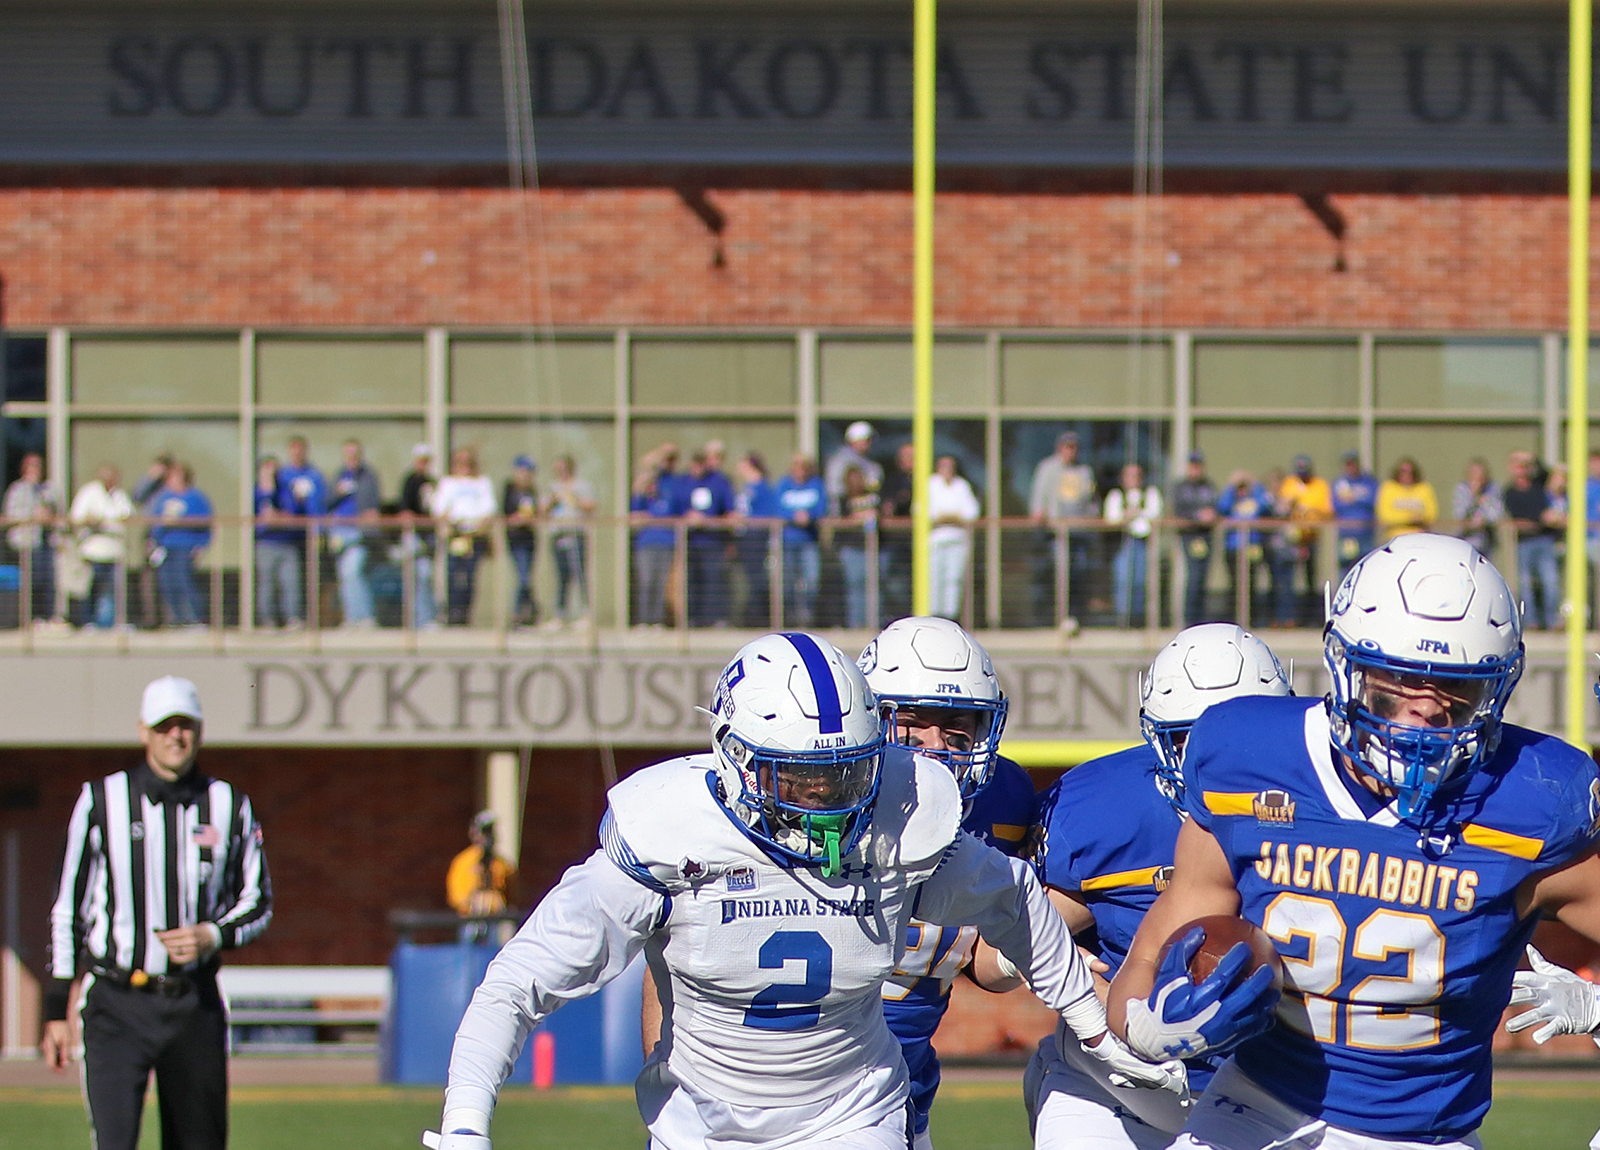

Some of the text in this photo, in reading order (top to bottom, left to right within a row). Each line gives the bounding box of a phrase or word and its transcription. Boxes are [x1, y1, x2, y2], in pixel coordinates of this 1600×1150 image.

[105, 35, 481, 120] SOUTH
[533, 35, 984, 121] DAKOTA
[1023, 40, 1354, 125] STATE
[1416, 638, 1451, 655] JFPA
[813, 736, 846, 750] ALL IN
[1254, 841, 1479, 912] JACKRABBITS
[721, 900, 875, 925] INDIANA STATE
[743, 930, 833, 1030] 2
[1262, 891, 1447, 1051] 22
